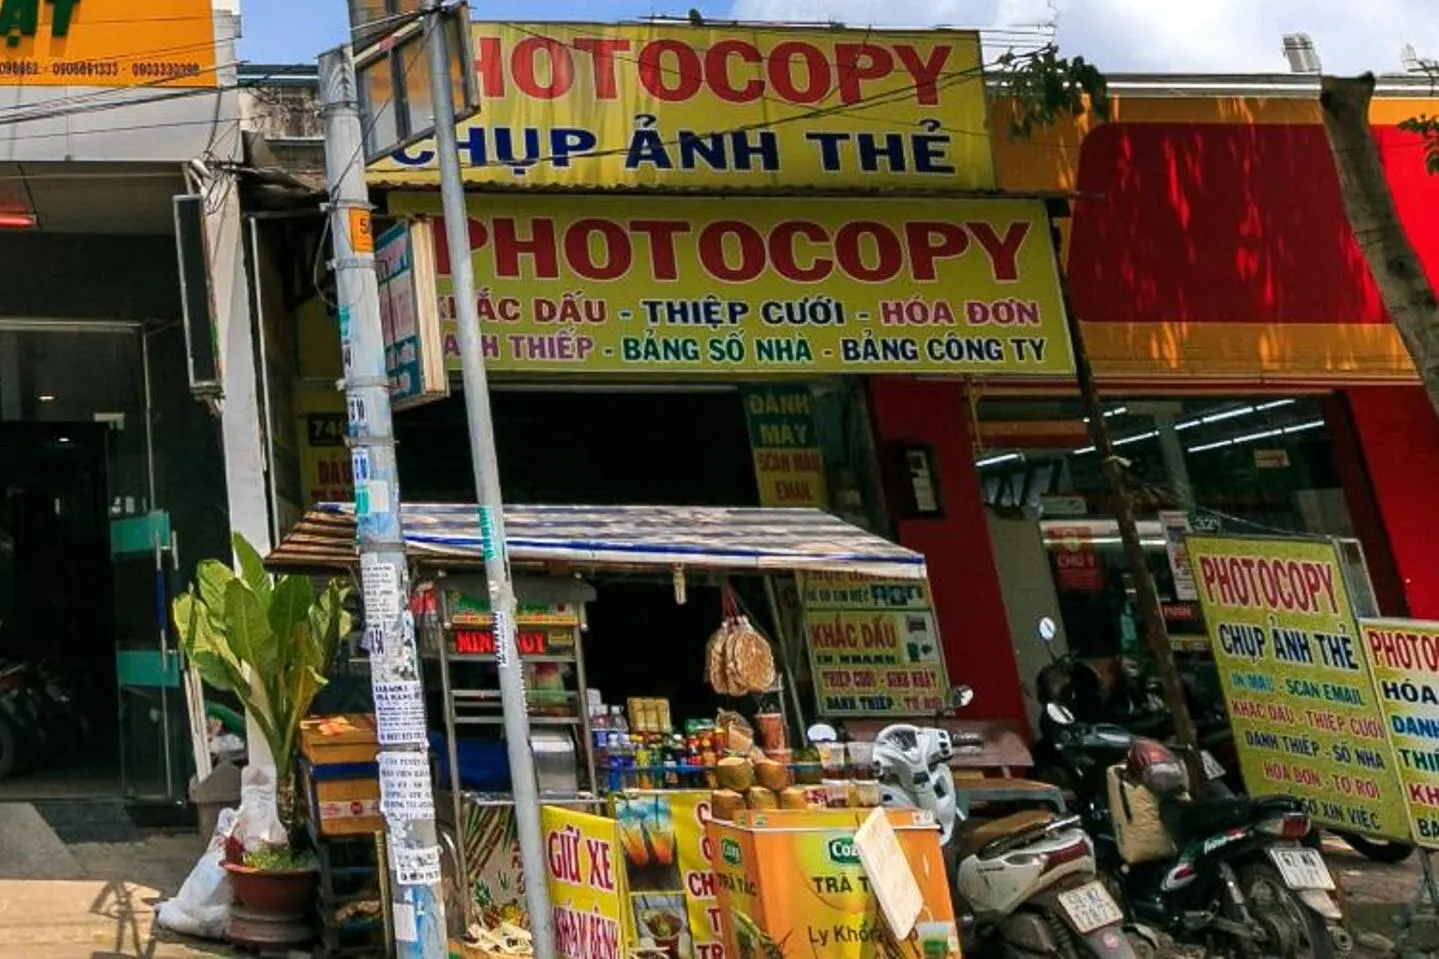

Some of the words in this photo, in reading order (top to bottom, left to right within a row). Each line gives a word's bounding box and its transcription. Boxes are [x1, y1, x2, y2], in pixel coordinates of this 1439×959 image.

[471, 36, 953, 108] HOTOCOPY
[625, 114, 779, 173] ẢNH
[806, 118, 956, 176] THẺ
[430, 216, 1033, 284] PHOTOCOPY
[533, 289, 606, 323] DẤU
[642, 294, 750, 330] THIỆP
[761, 296, 847, 326] CƯỚI
[880, 295, 956, 326] HÓA
[965, 300, 1041, 326] ĐƠN
[509, 328, 593, 359] THIẾP
[622, 328, 700, 362] BẢNG
[708, 328, 747, 362] SỐ
[755, 331, 814, 362] NHÀ
[841, 328, 919, 362] BẢNG
[927, 332, 1005, 362] CÔNG
[1012, 338, 1048, 362] TY
[1198, 555, 1340, 615] PHOTOCOPY
[1217, 623, 1266, 664] CHỤP
[1269, 615, 1314, 665] ẢNH
[1314, 623, 1359, 671] THẺ
[1285, 678, 1321, 700] SCAN
[1323, 683, 1366, 707] EMAIL
[1321, 799, 1346, 824] XIN
[547, 823, 582, 884] GIỮ
[585, 838, 614, 891] XE
[830, 841, 863, 858] Coz
[811, 871, 853, 894] TRÀ
[806, 925, 829, 947] Ly
